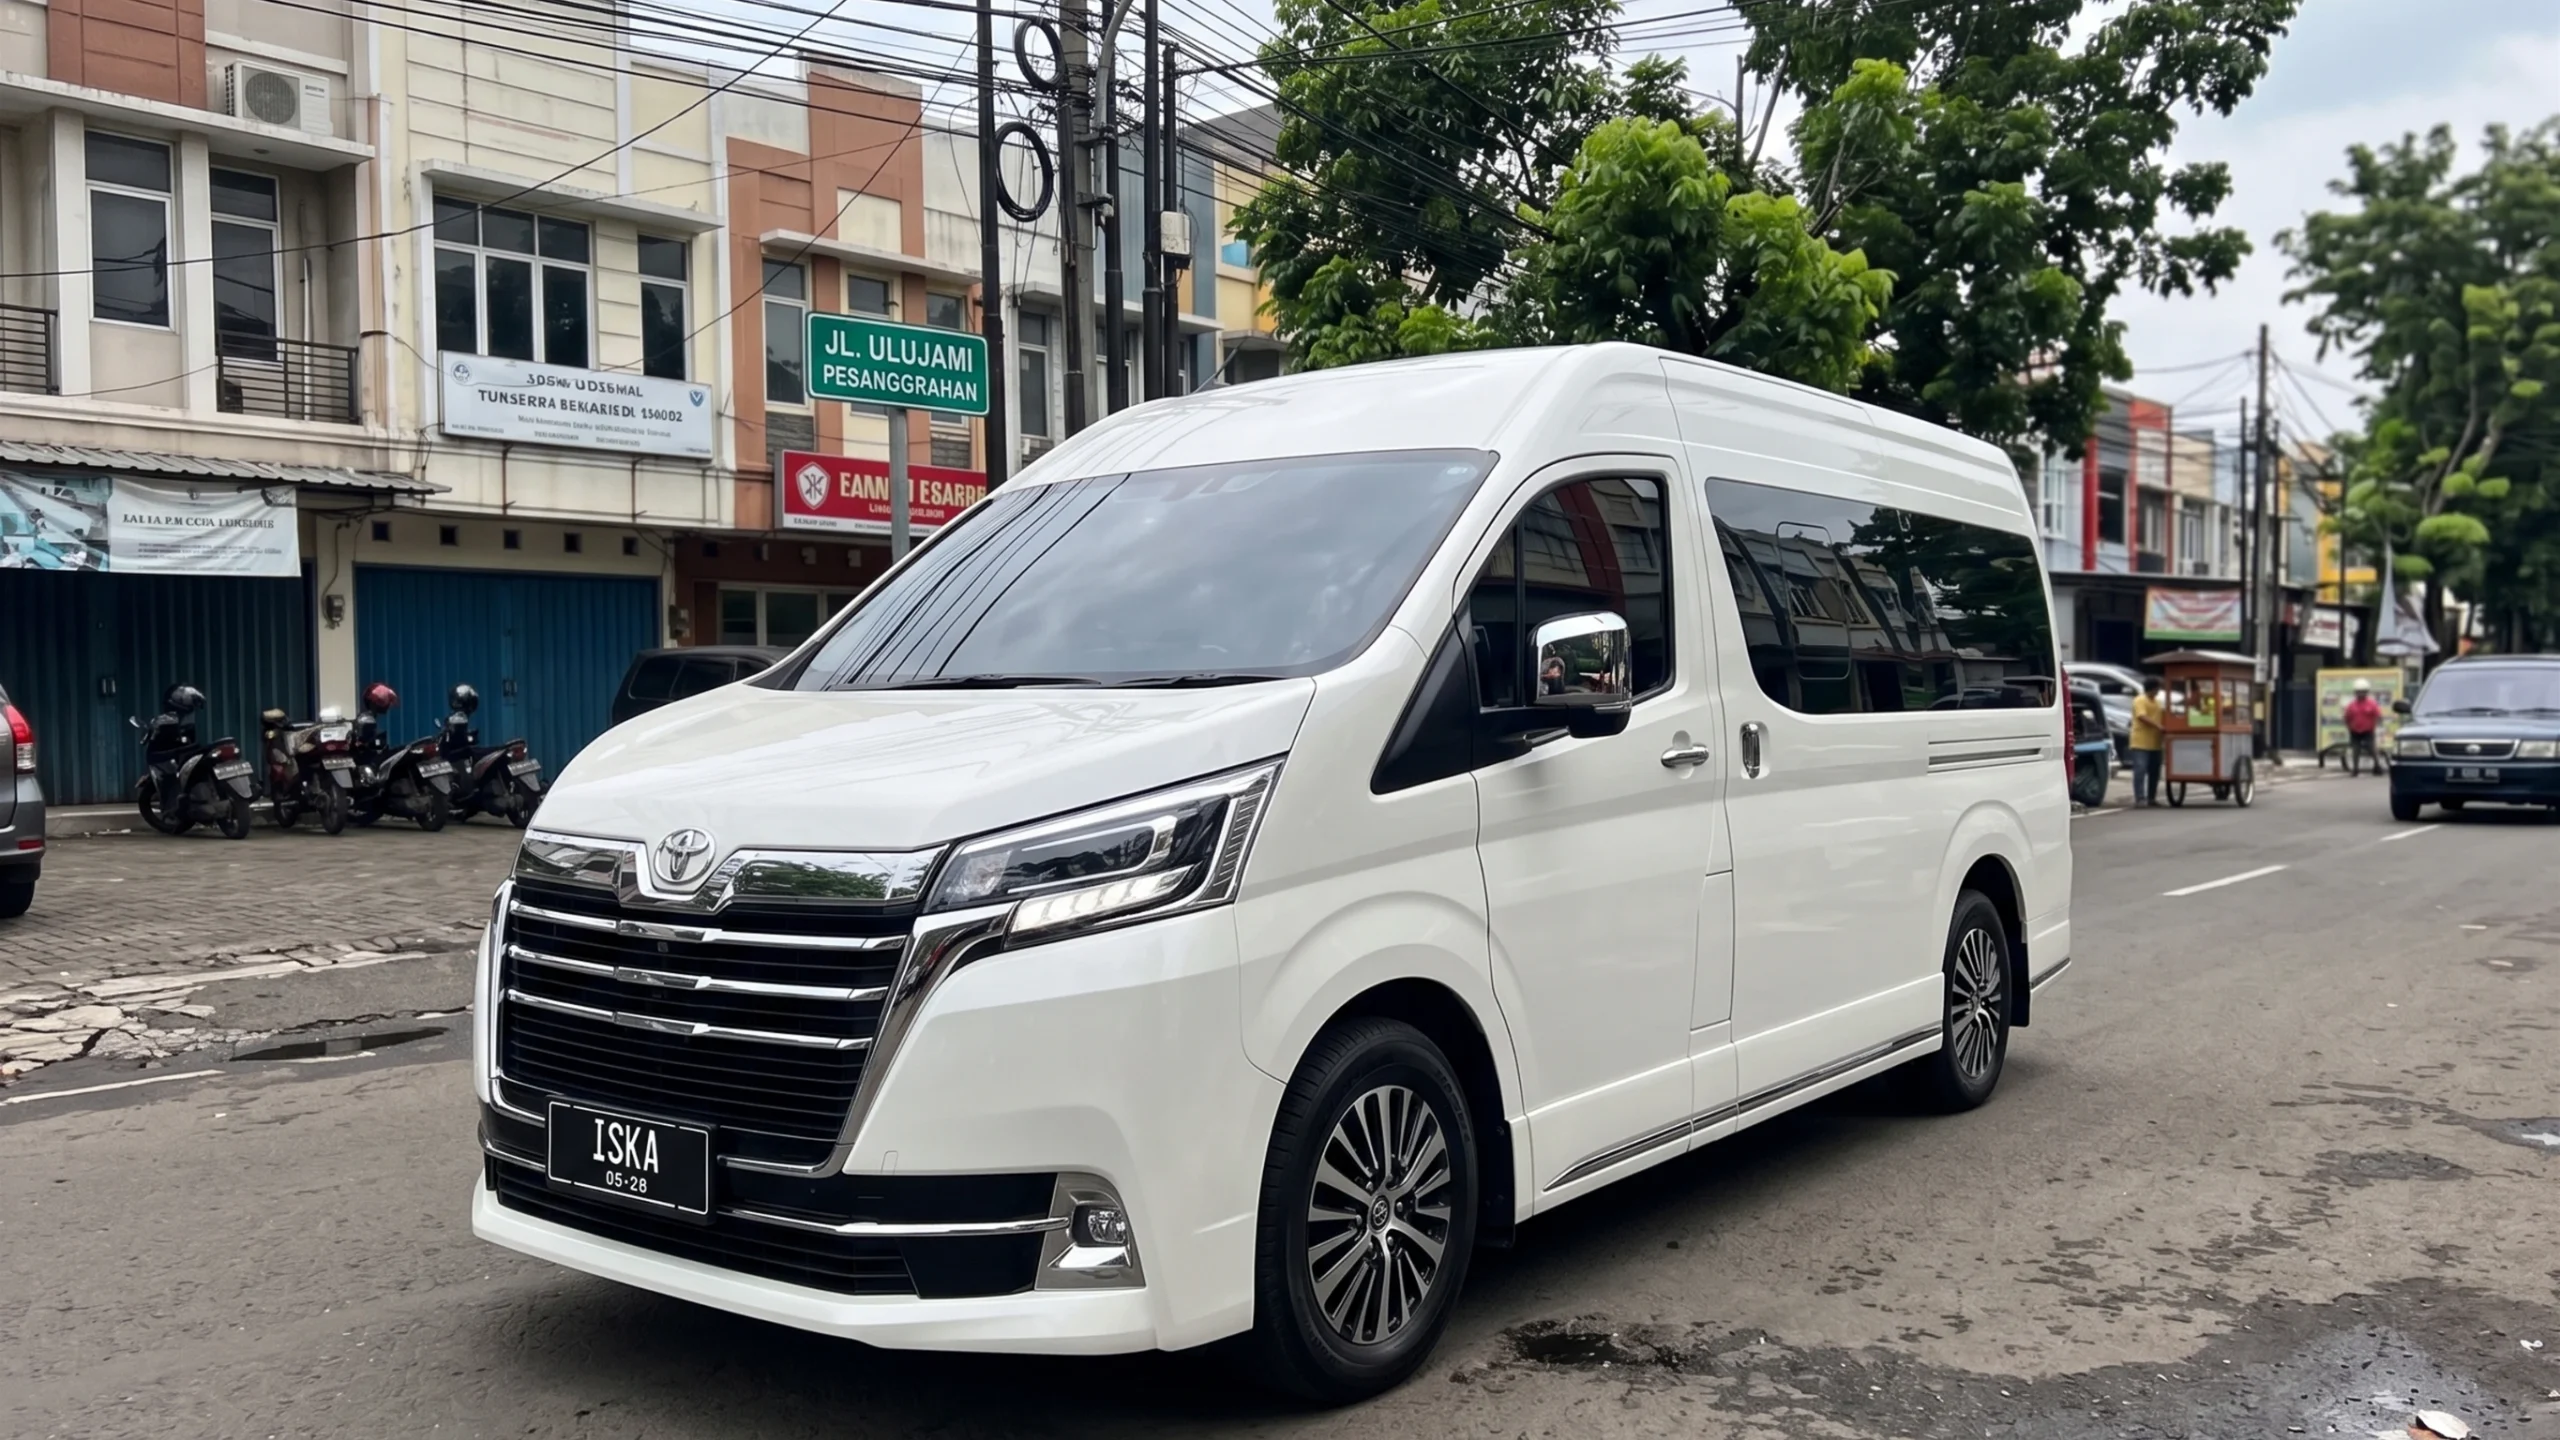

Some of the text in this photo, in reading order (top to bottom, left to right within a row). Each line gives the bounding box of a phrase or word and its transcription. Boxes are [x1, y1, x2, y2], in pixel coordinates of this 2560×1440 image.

[825, 330, 973, 373] JL. ULUJAMI
[823, 364, 978, 402] PESANGGRAHAN
[593, 1118, 659, 1174] ISKA
